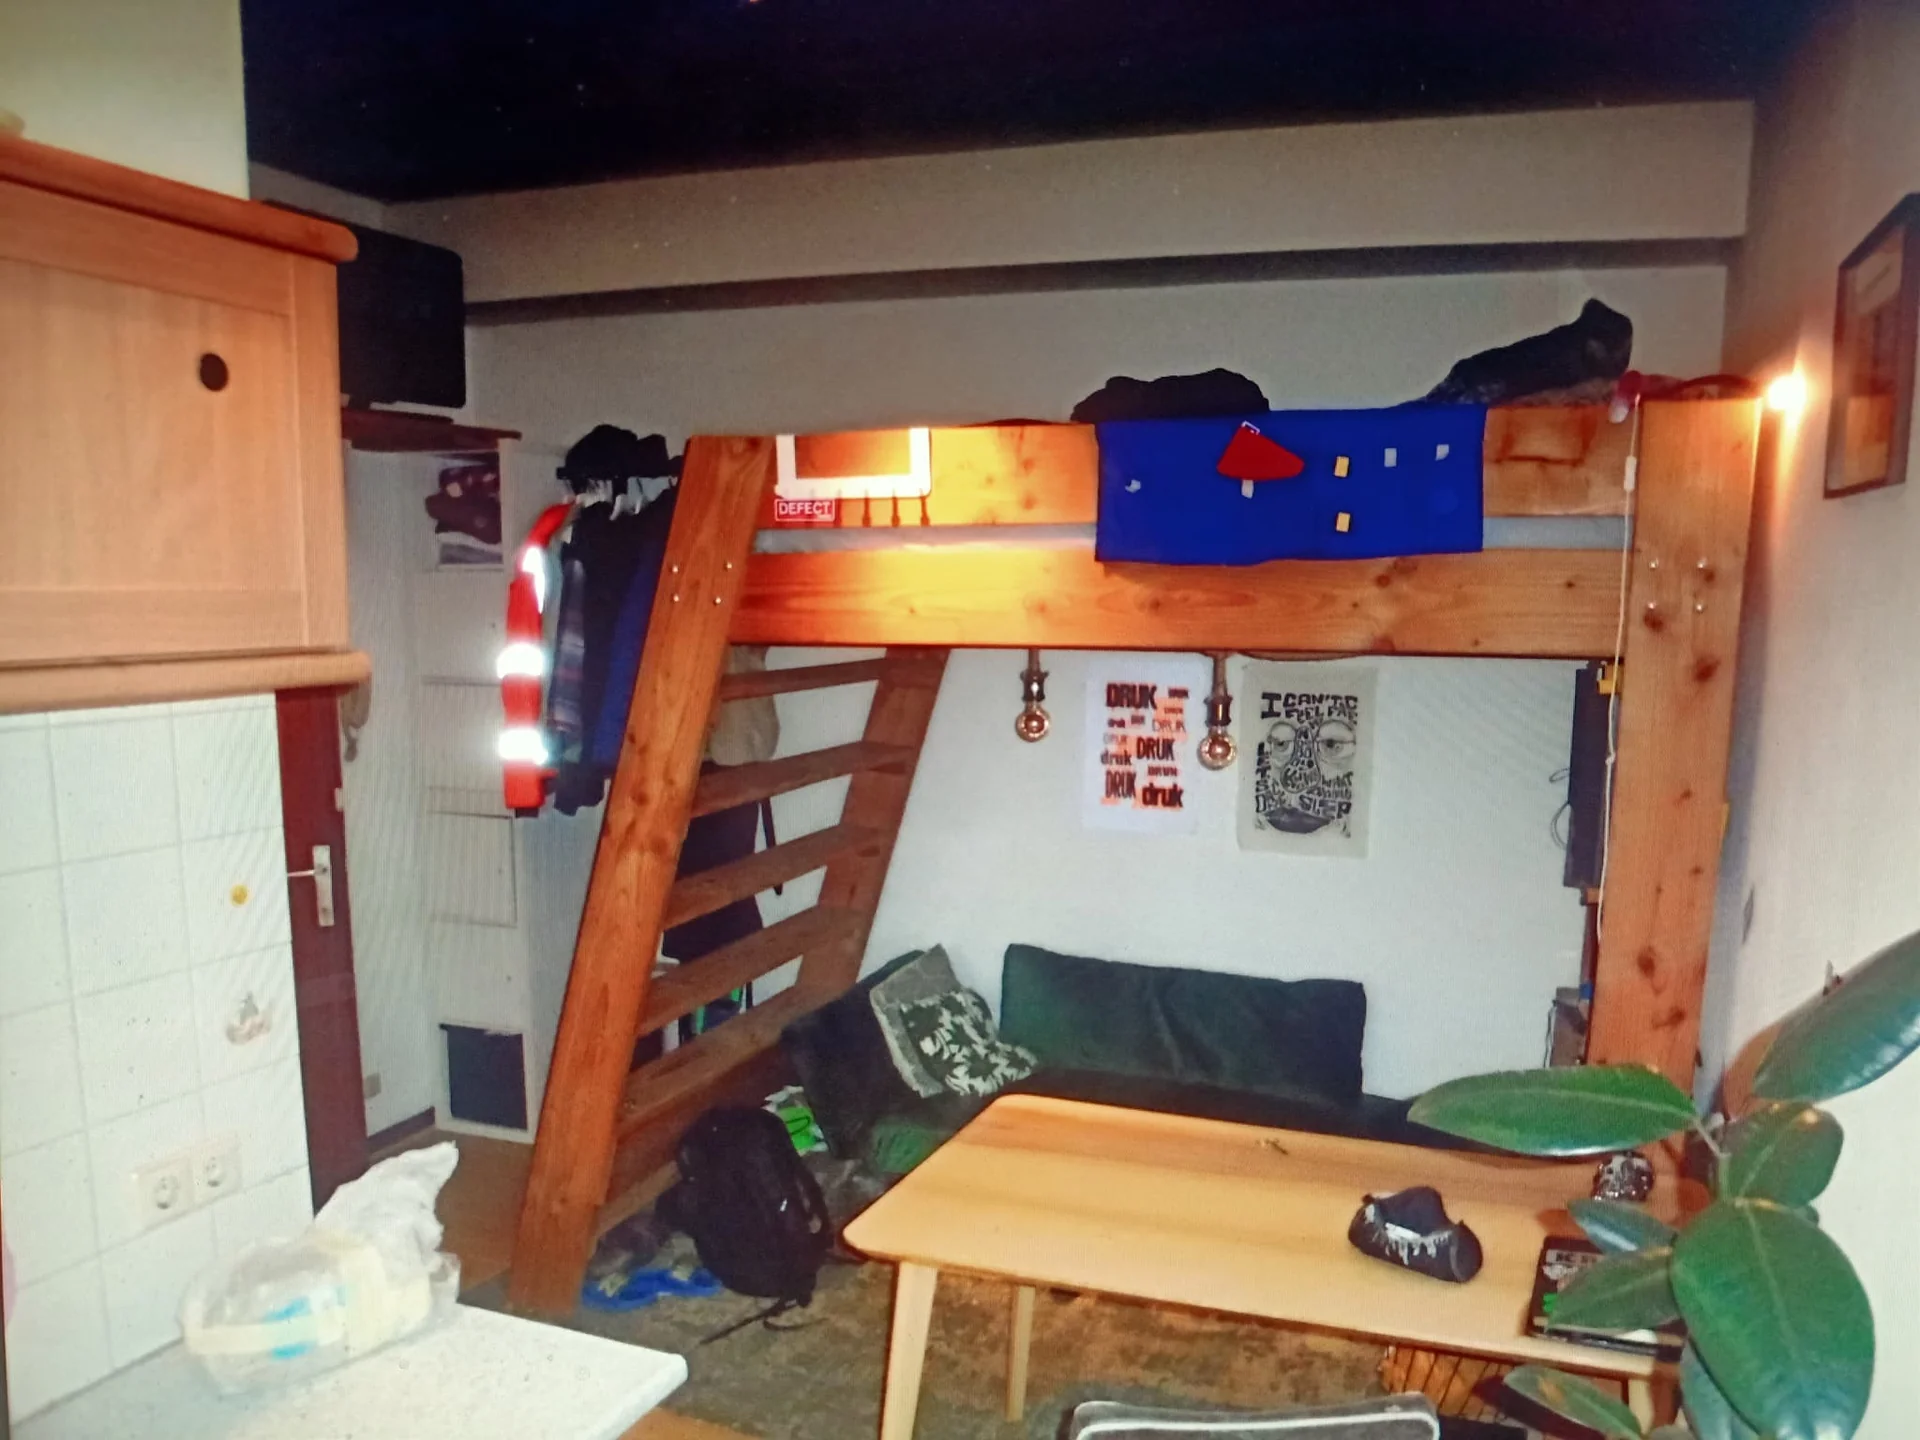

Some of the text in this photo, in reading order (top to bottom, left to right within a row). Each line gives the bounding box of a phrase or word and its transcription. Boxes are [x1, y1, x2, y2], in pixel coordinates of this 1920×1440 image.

[778, 501, 831, 515] DEFECT
[1106, 683, 1157, 709] DRUK
[1261, 692, 1281, 718] I
[1136, 736, 1175, 760] DRUK
[1142, 782, 1183, 807] druk
